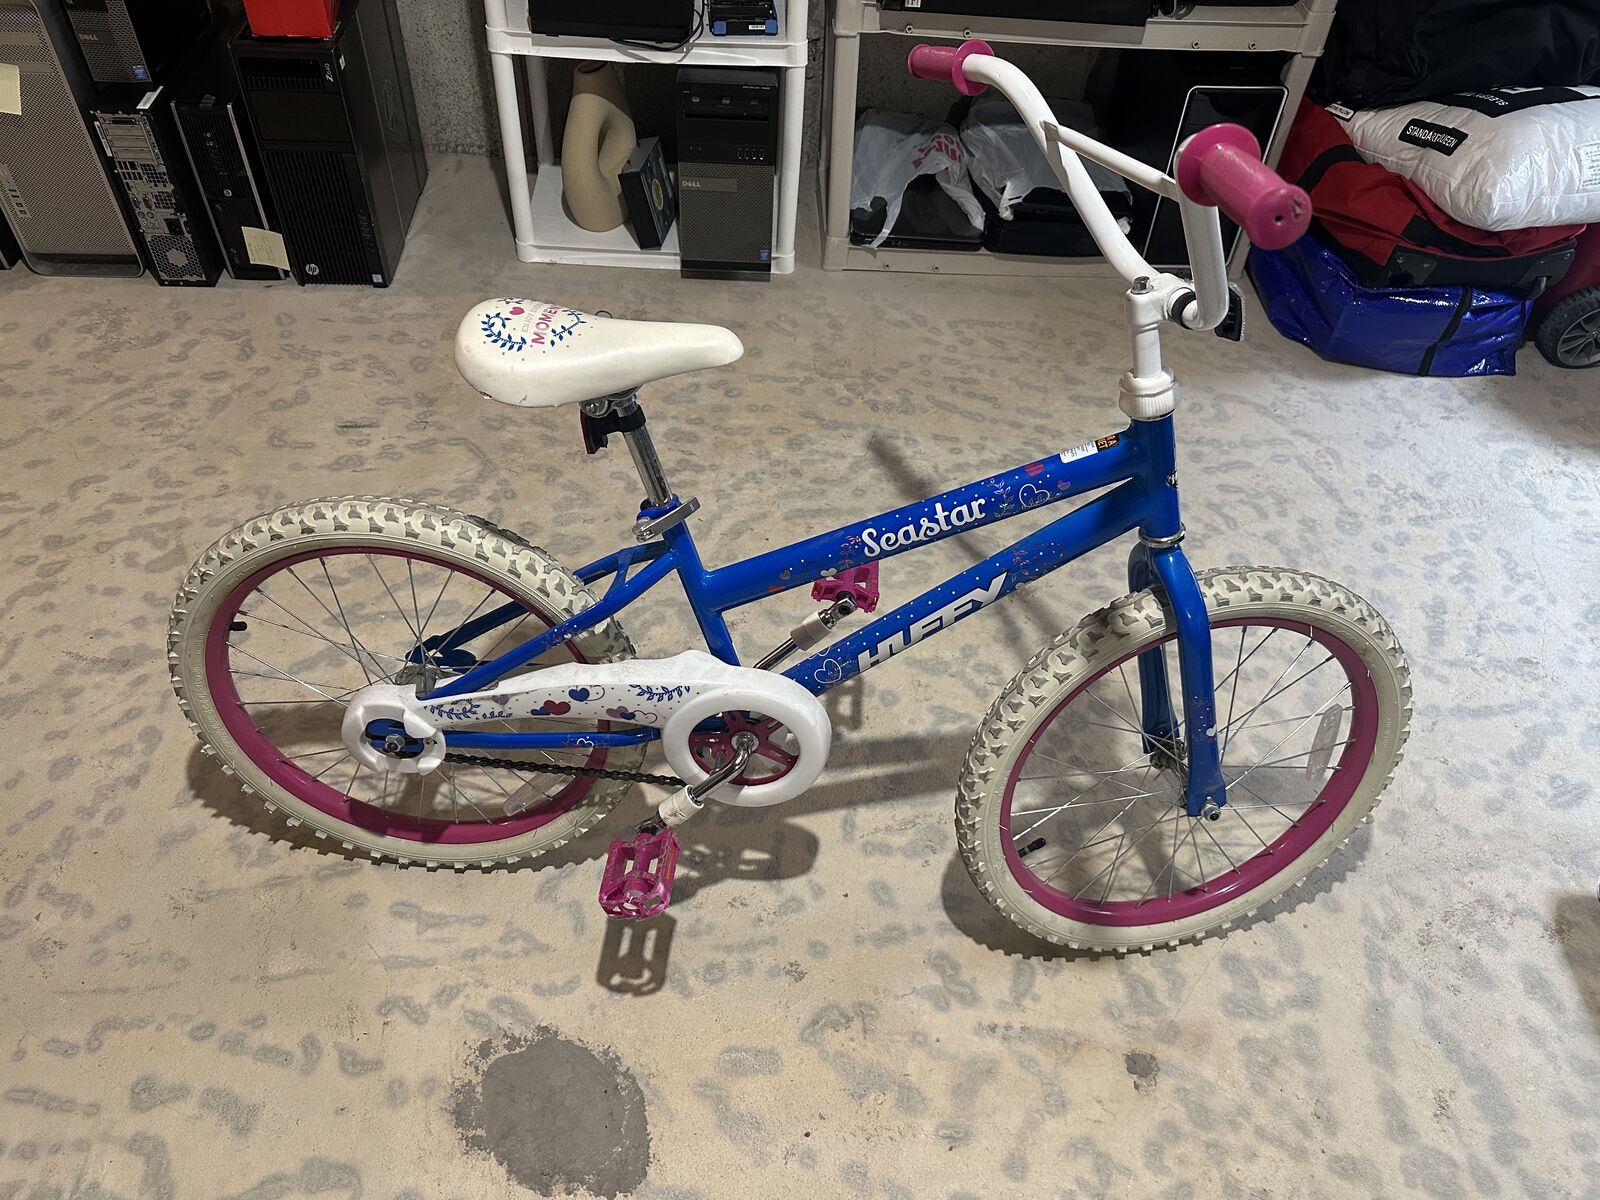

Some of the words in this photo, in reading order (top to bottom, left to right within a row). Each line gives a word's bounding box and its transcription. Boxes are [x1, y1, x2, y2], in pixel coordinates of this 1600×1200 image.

[306, 263, 319, 275] hp
[861, 498, 986, 557] Seastar
[857, 571, 1008, 673] HUFFY
